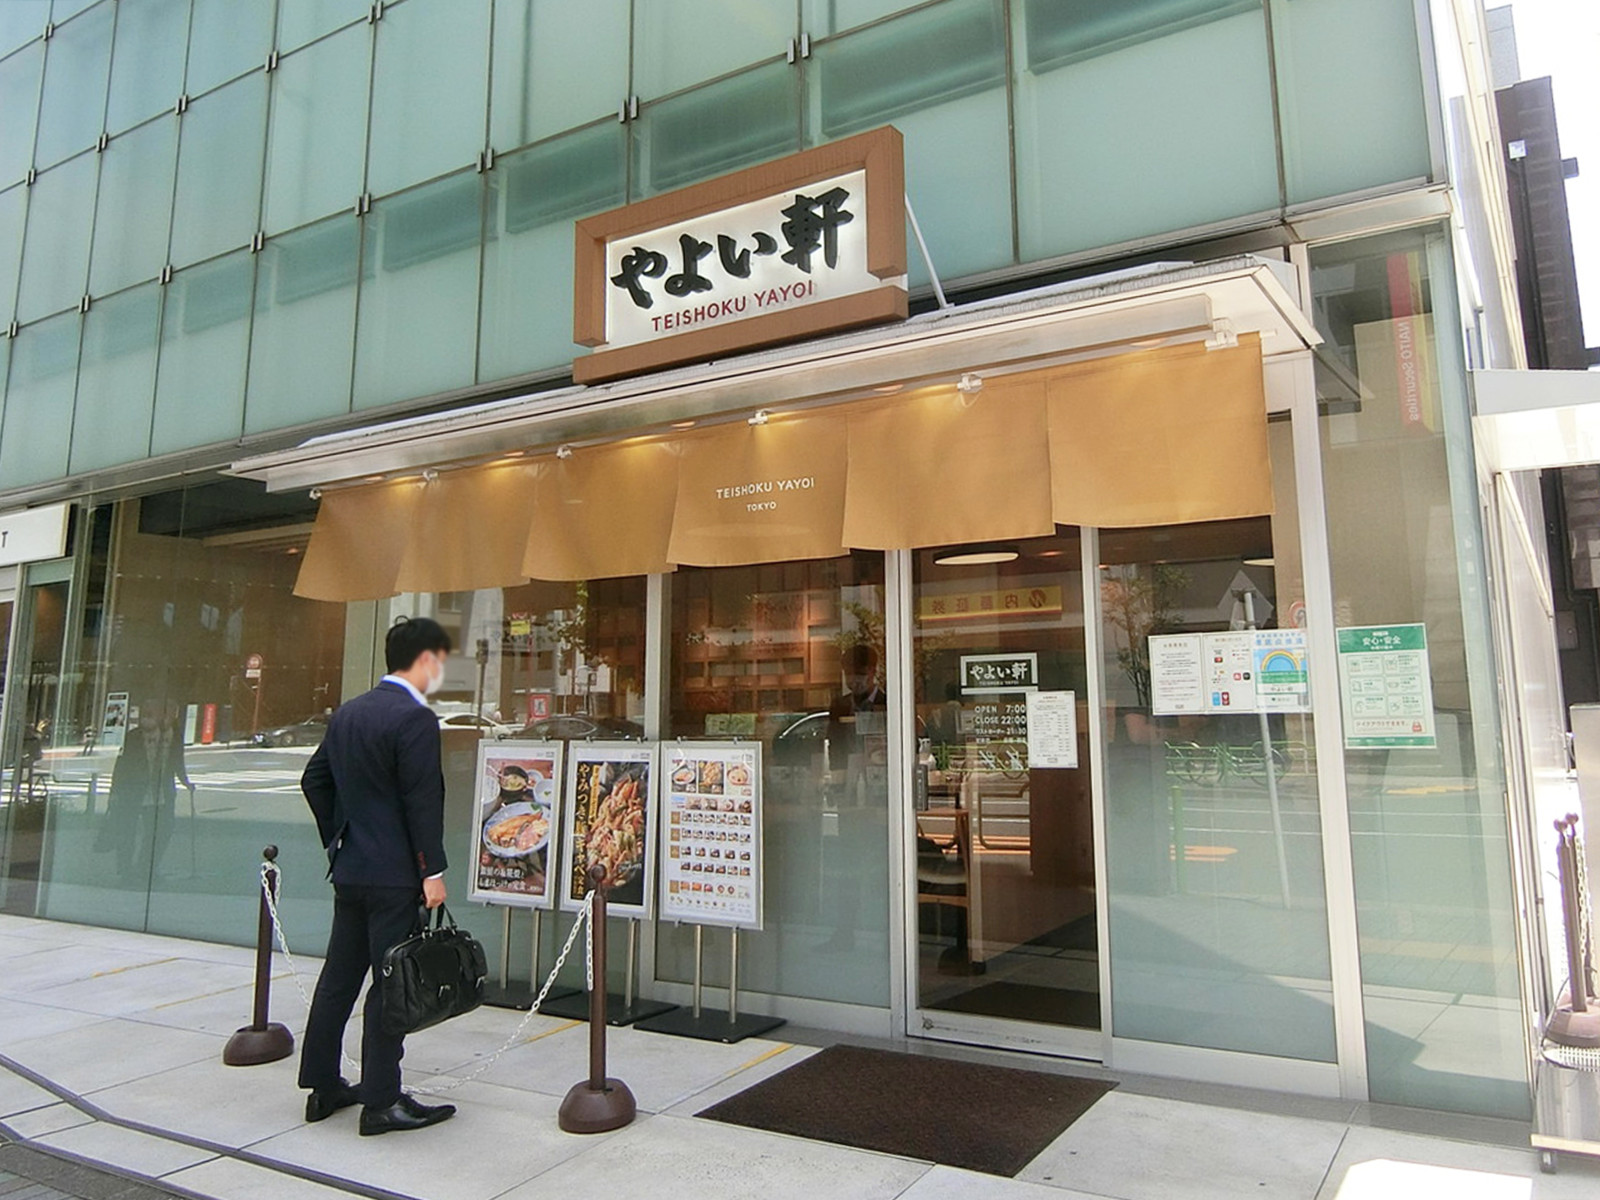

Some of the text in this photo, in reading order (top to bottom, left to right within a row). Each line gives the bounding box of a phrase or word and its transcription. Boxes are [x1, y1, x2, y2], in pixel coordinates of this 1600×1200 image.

[611, 187, 854, 309] やよい軒
[652, 280, 814, 332] TEISHOKU YAYOI
[716, 477, 815, 499] TEISHOKU YAYOI
[747, 501, 777, 512] TOKYO
[2, 531, 8, 548] T
[1362, 635, 1401, 646] 安心・安全
[970, 662, 1028, 680] やよい軒
[975, 704, 1026, 713] OPEN 7:00
[975, 715, 1026, 724] CLOSE 22:00
